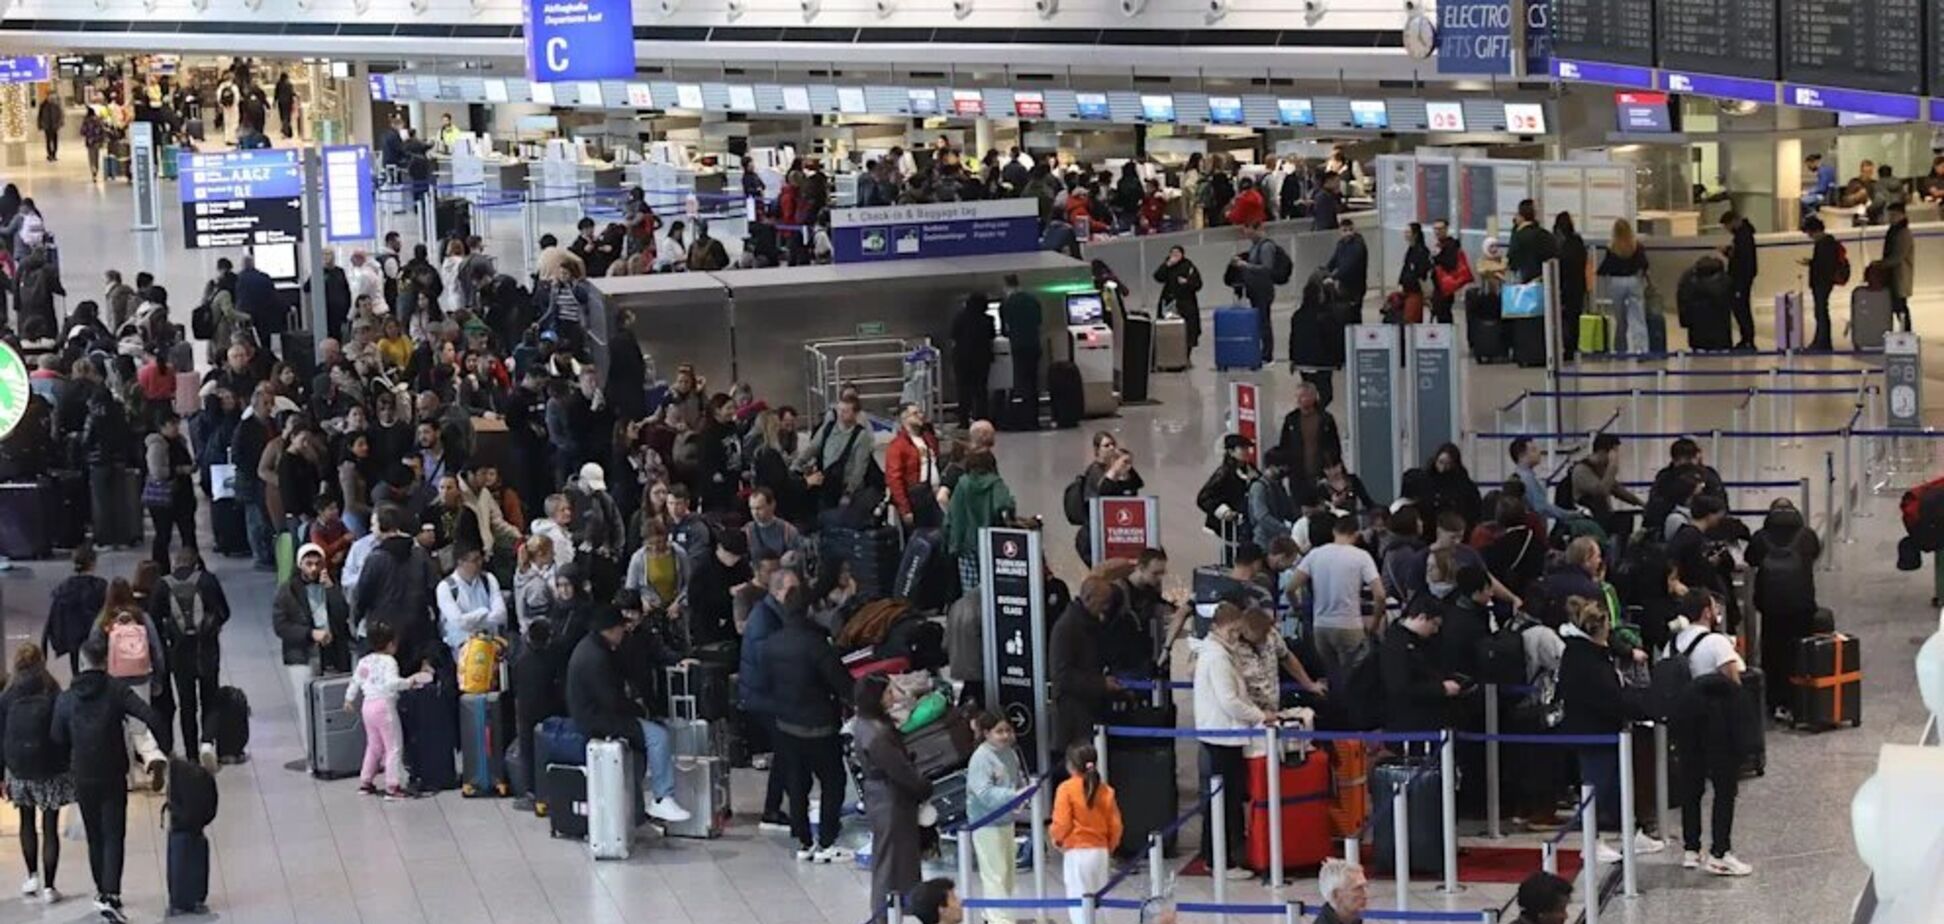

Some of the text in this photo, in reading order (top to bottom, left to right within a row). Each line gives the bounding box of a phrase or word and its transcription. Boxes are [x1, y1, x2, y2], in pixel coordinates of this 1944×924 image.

[1443, 4, 1548, 28] ELECTROCS
[547, 36, 569, 72] C
[1475, 35, 1511, 59] GIFT
